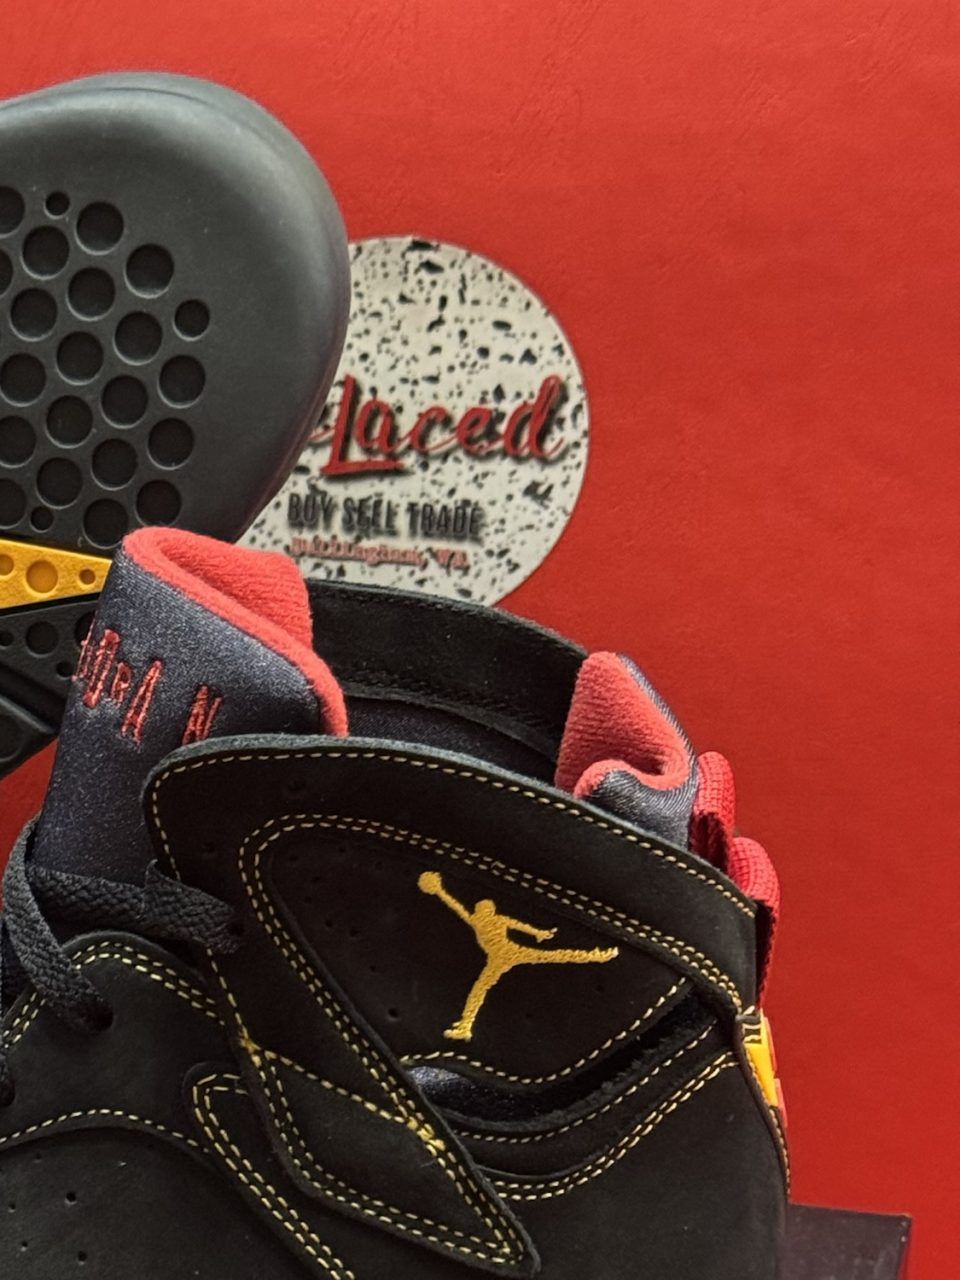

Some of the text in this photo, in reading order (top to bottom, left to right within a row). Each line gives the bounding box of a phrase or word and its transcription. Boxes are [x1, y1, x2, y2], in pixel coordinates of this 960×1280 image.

[288, 493, 484, 543] BUY SELL TRADE
